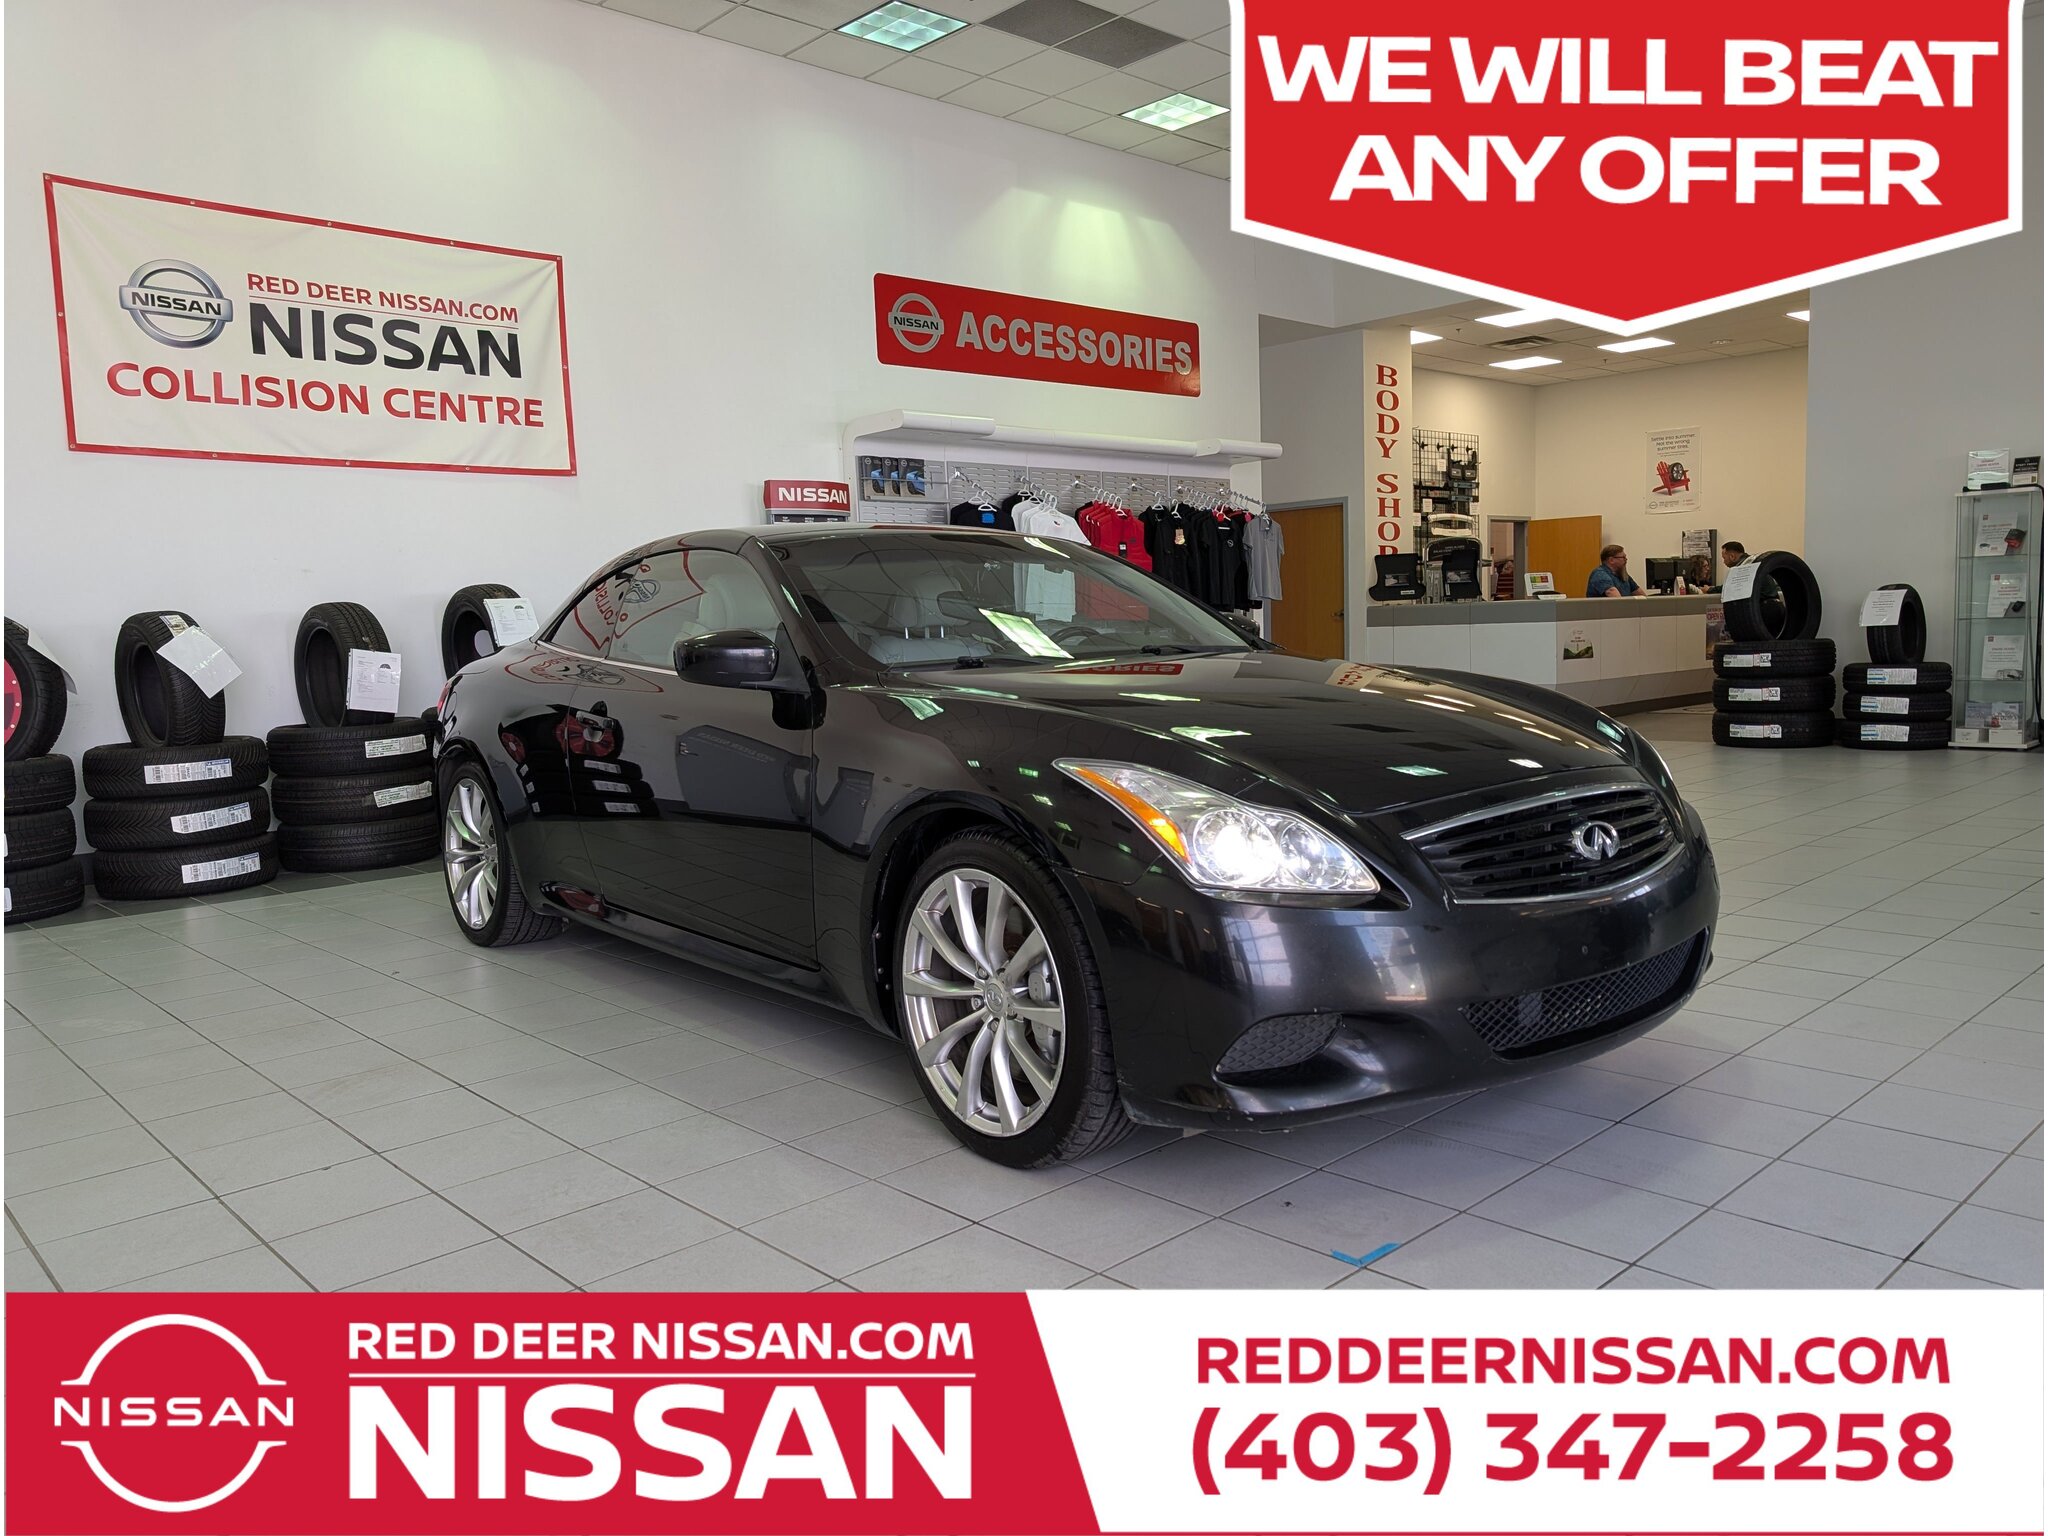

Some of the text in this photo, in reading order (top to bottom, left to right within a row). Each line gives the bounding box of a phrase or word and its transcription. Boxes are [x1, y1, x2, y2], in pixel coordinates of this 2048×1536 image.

[130, 291, 222, 316] NISSAN
[247, 273, 519, 323] RED DEER NISSAN.COM
[893, 315, 939, 331] NISSAN
[249, 302, 523, 379] NISSAN
[956, 311, 1193, 375] ACCESSORIES
[106, 361, 545, 428] COLLISION CENTRE
[1375, 364, 1401, 459] BODY
[778, 487, 848, 505] NISSAN
